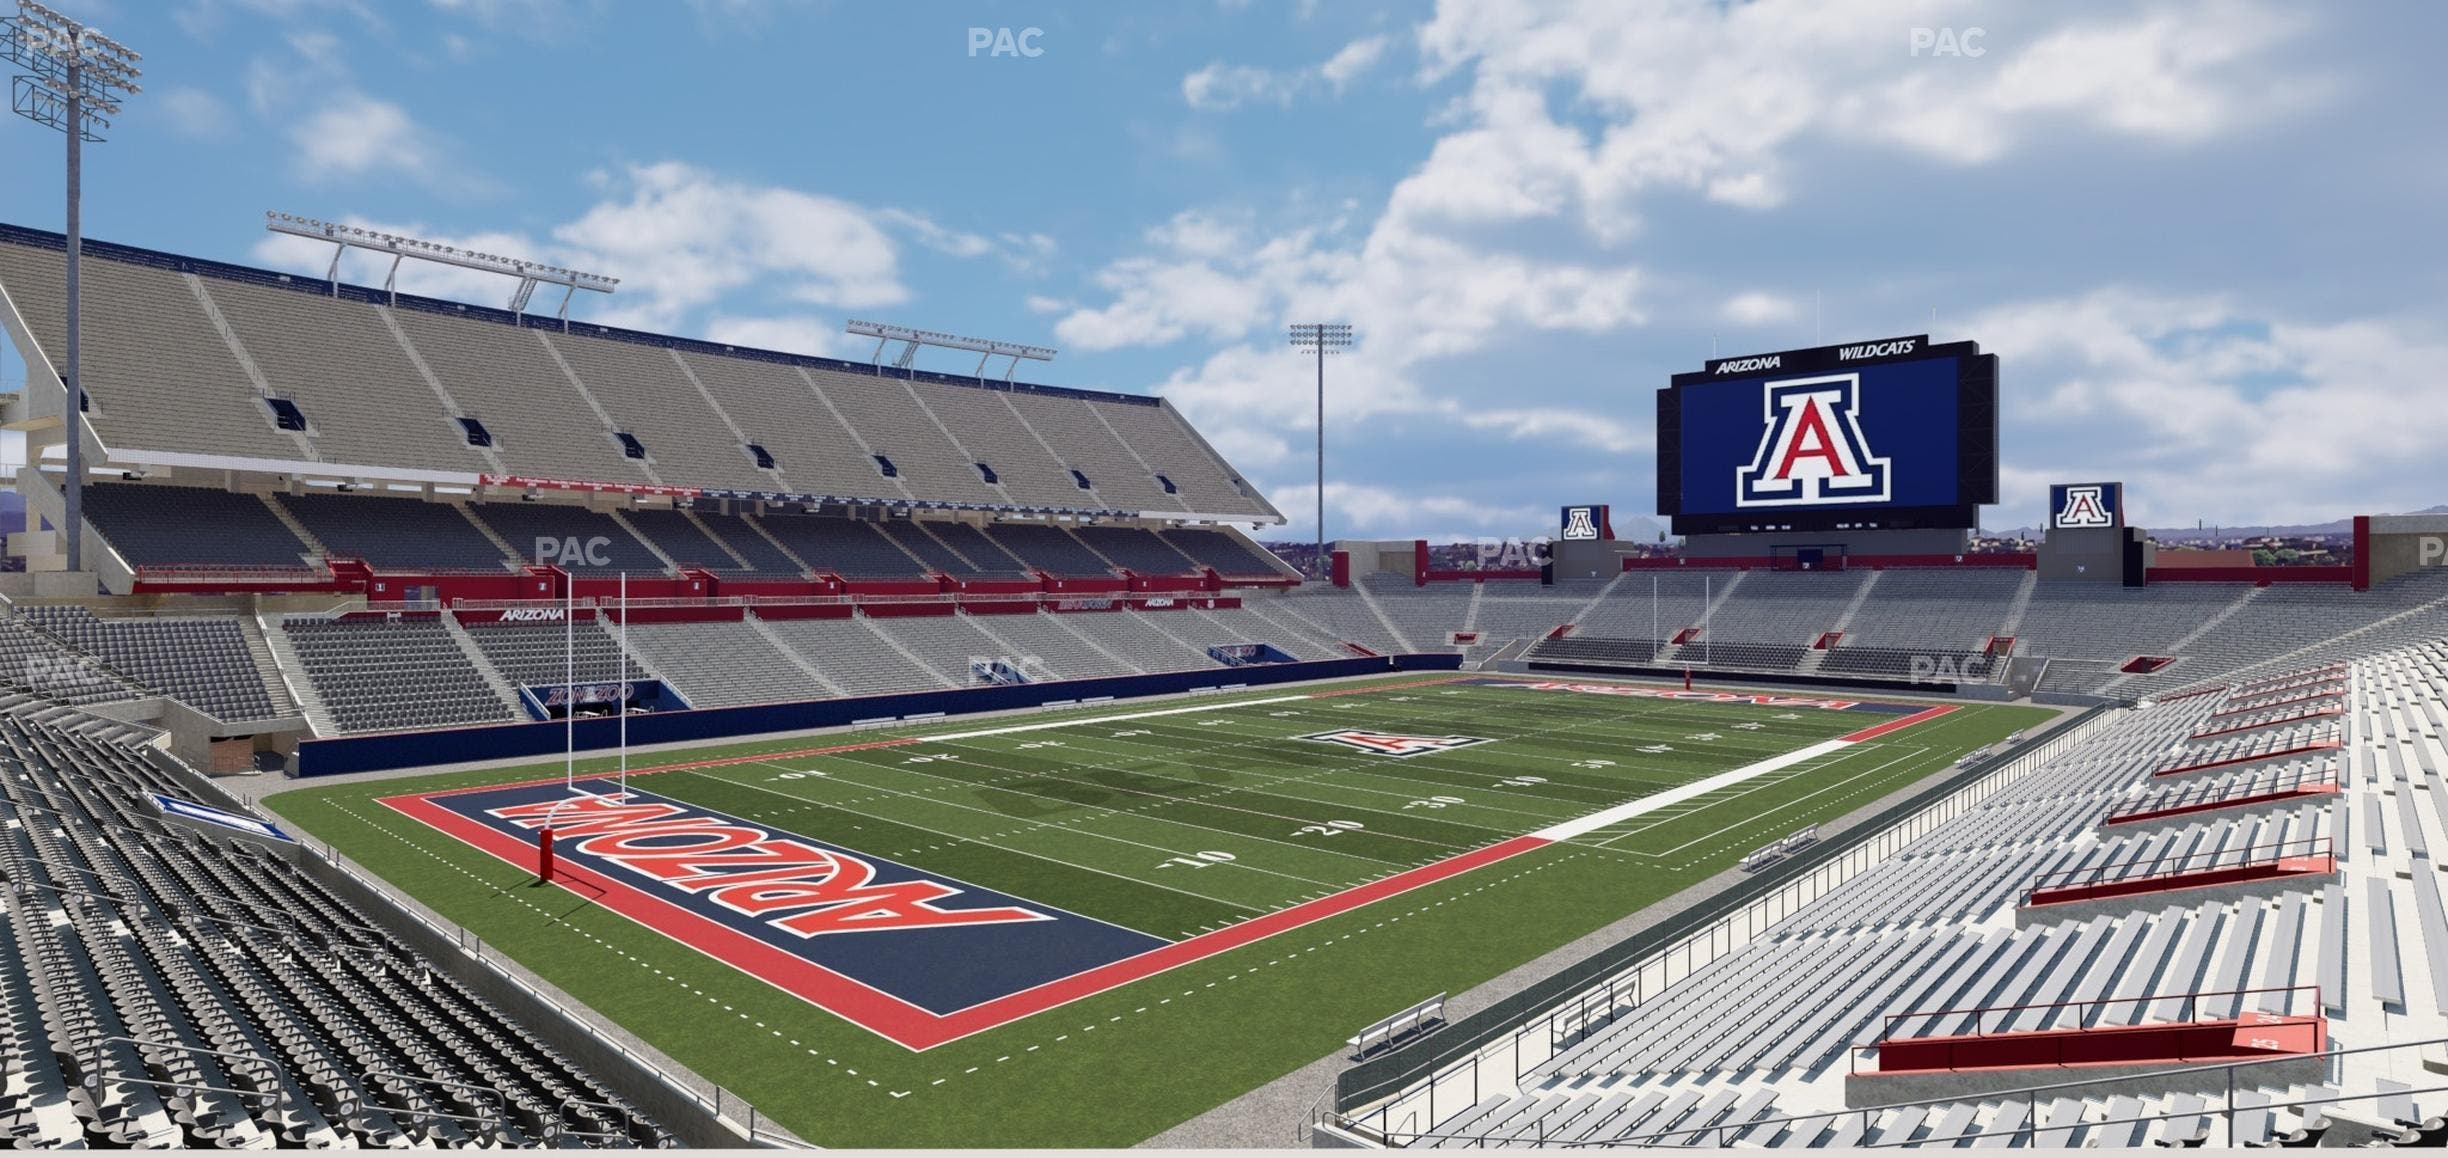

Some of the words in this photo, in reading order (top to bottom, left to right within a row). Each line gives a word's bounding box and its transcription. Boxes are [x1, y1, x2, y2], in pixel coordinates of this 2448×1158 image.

[1715, 356, 1781, 375] ARIZONA
[1839, 340, 1916, 361] WILDCATS
[499, 608, 565, 621] ARIZONA
[1301, 820, 1364, 836] 20
[484, 792, 1058, 939] ARIZONA
[1165, 850, 1237, 869] 10
